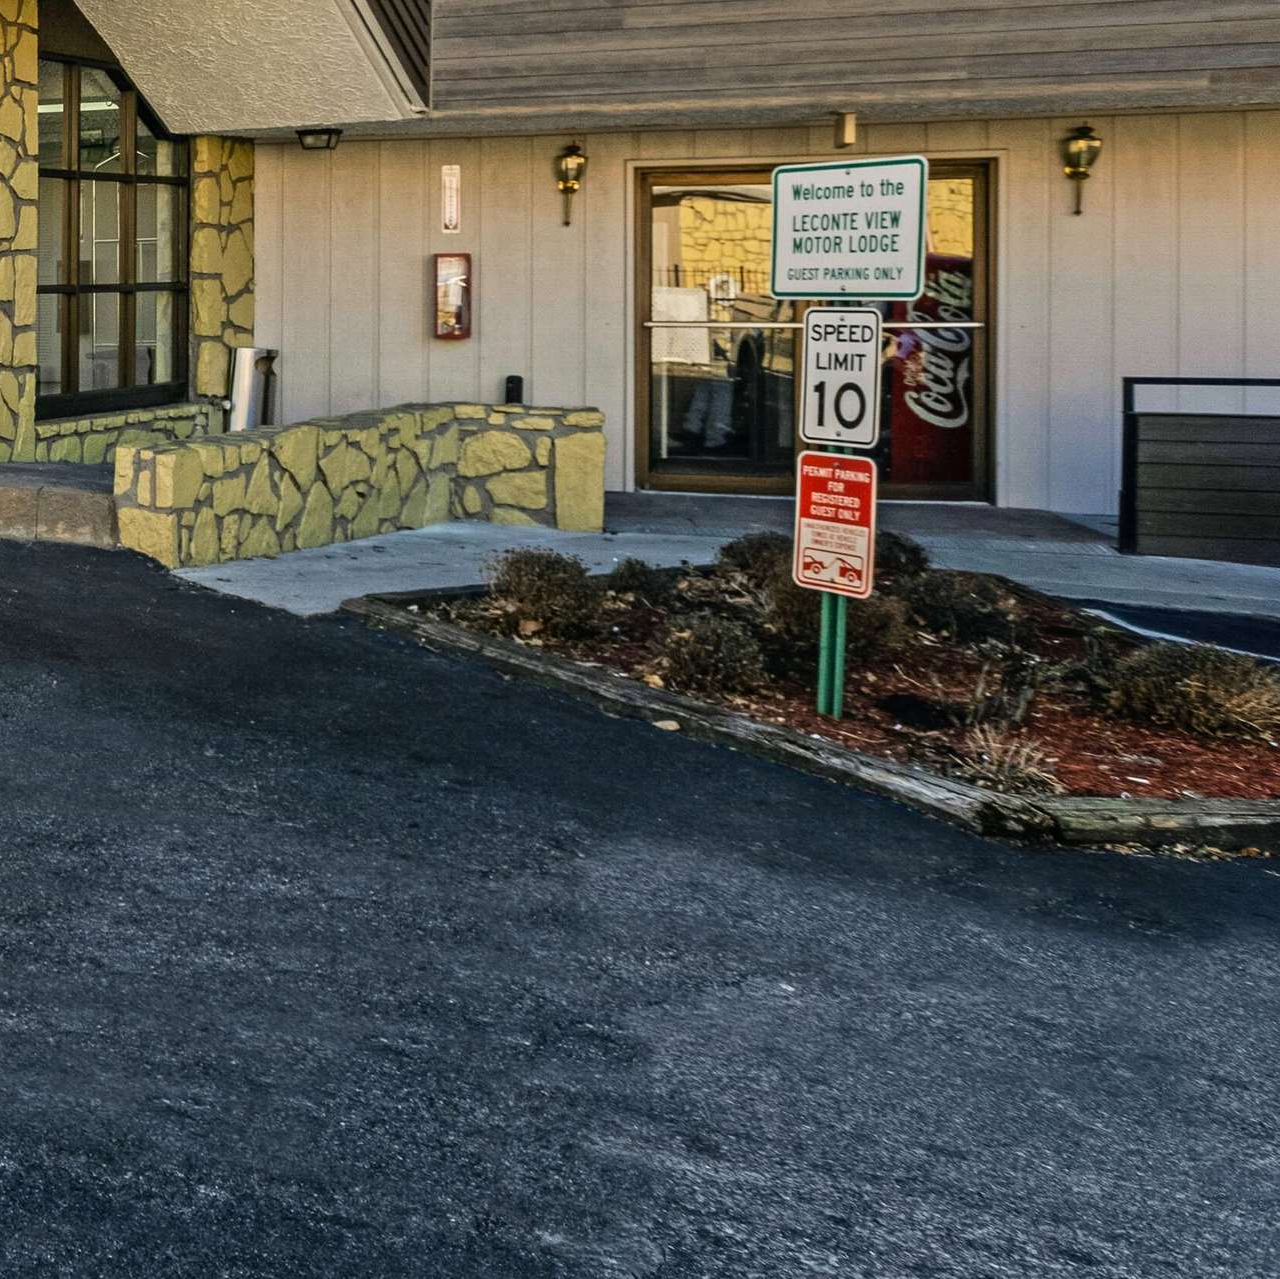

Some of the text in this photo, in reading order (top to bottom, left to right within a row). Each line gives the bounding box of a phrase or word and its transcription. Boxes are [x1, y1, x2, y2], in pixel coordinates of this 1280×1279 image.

[792, 179, 905, 201] Welcome to the
[792, 210, 902, 233] LECONTE VIEW
[792, 234, 900, 254] MOTOR LODGE
[787, 267, 904, 281] GUEST PARKING ONLY
[811, 323, 873, 343] SPEED
[816, 353, 867, 372] LIMIT
[813, 380, 866, 430] 10
[802, 465, 871, 484] PERMIT PARKING
[827, 481, 845, 492] FOR
[811, 491, 861, 508] REGISTERED
[810, 505, 861, 521] GUEST ONLY
